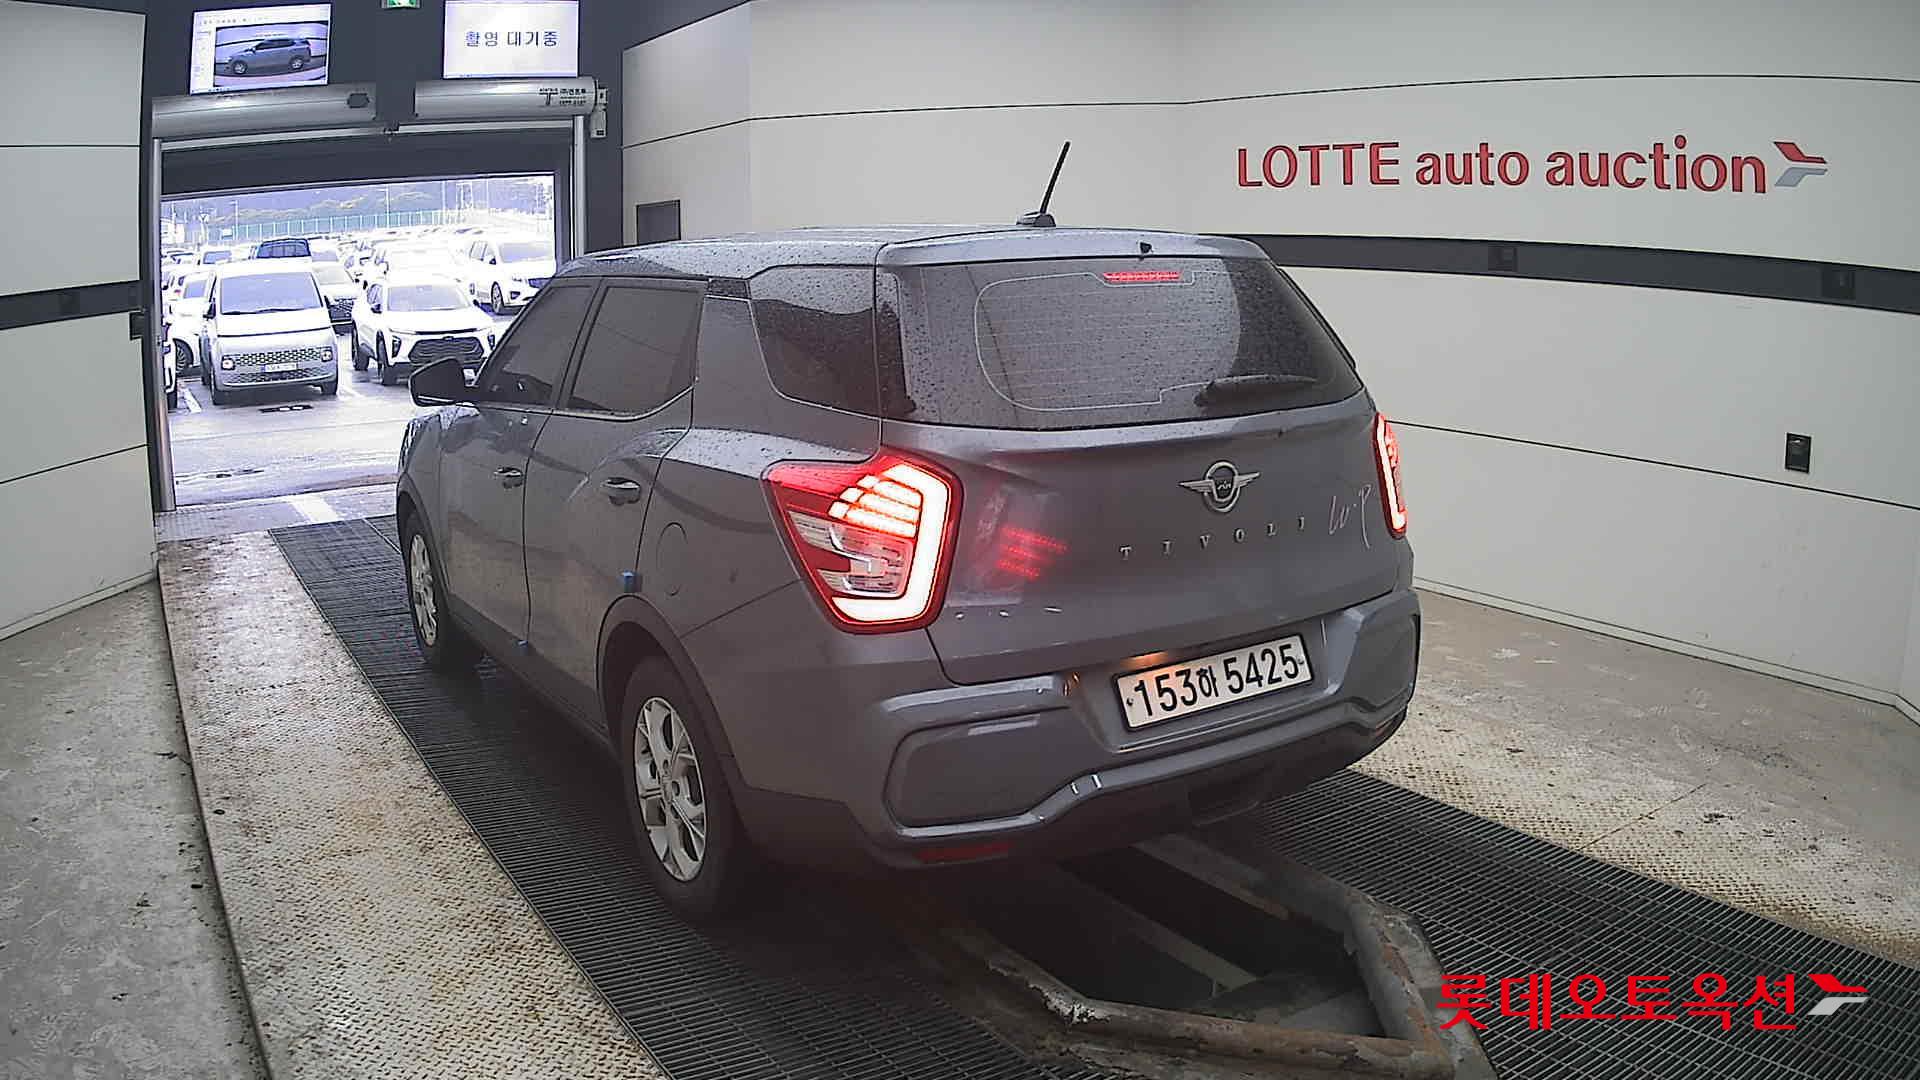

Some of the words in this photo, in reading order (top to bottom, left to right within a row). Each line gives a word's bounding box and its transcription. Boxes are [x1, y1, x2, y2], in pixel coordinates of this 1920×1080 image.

[507, 30, 558, 47] 대기중
[1238, 141, 1400, 188] LOTTE
[1415, 142, 1530, 187] auto
[1545, 134, 1767, 194] auction
[1120, 516, 1304, 560] TIVOLI
[1223, 644, 1299, 694] 5425
